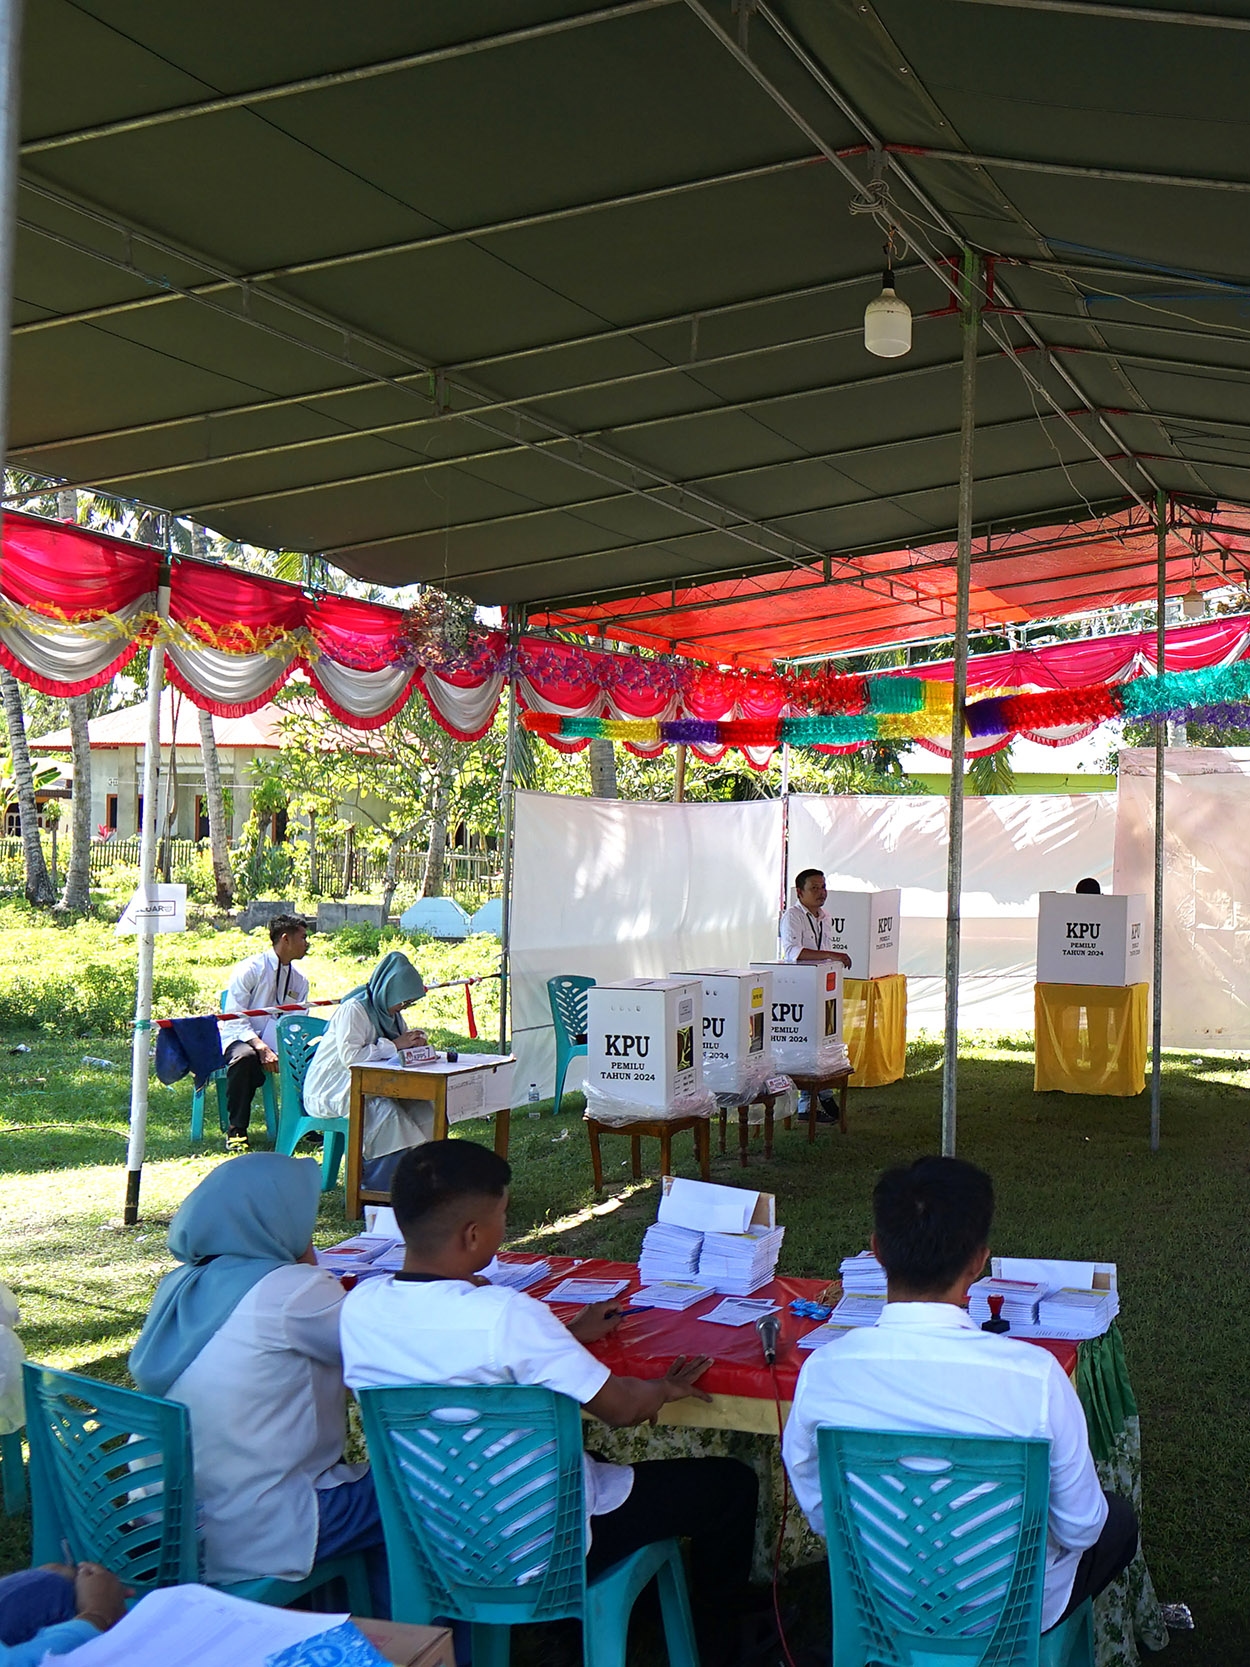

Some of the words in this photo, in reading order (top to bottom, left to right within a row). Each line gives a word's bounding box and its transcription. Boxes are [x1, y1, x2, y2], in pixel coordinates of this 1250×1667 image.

[878, 917, 893, 933] KPU
[1066, 922, 1101, 939] KPU
[702, 1017, 726, 1038] PU
[788, 1035, 808, 1043] 2024
[605, 1034, 651, 1058] KPU
[709, 1052, 729, 1060] 2024
[611, 1062, 646, 1070] PEMILU
[600, 1071, 631, 1080] TAHUN
[634, 1073, 656, 1081] 2024
